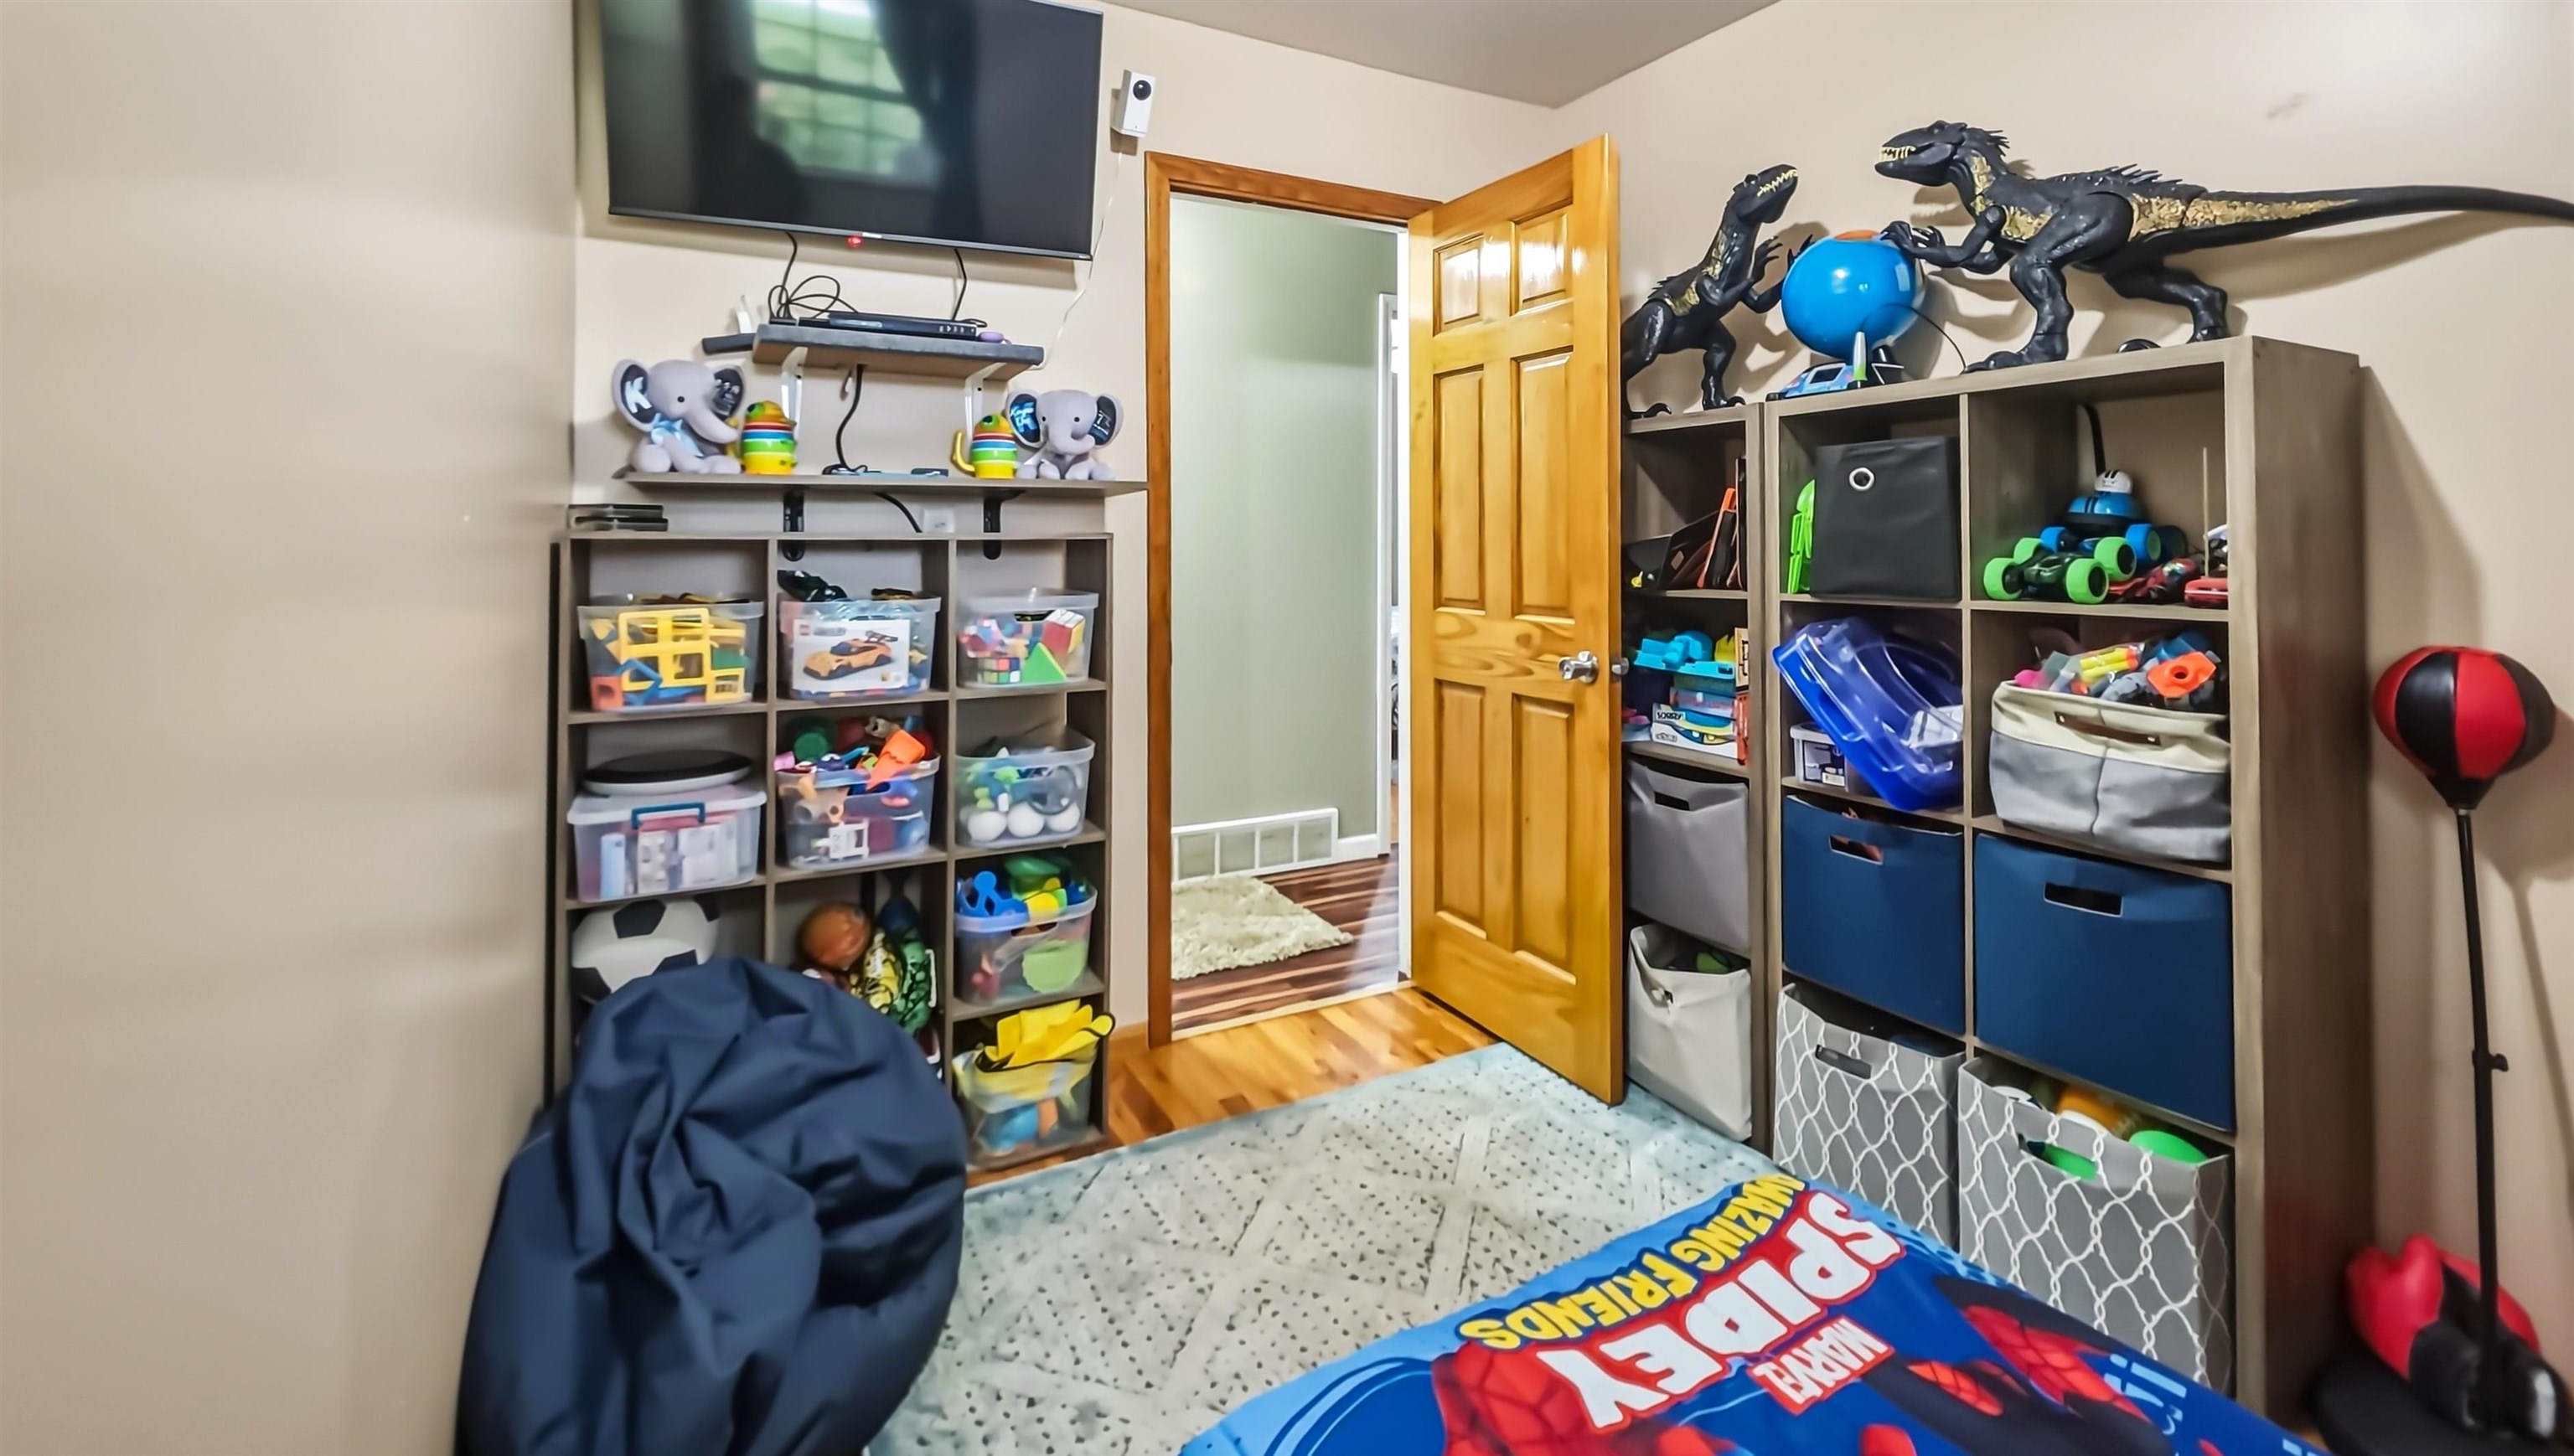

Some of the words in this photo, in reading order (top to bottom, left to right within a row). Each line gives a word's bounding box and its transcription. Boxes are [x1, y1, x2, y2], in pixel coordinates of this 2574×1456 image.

[1460, 1252, 1698, 1350] FRIENDS
[1536, 1192, 1901, 1428] SPIDEY
[1752, 1318, 1889, 1405] MARVEL
